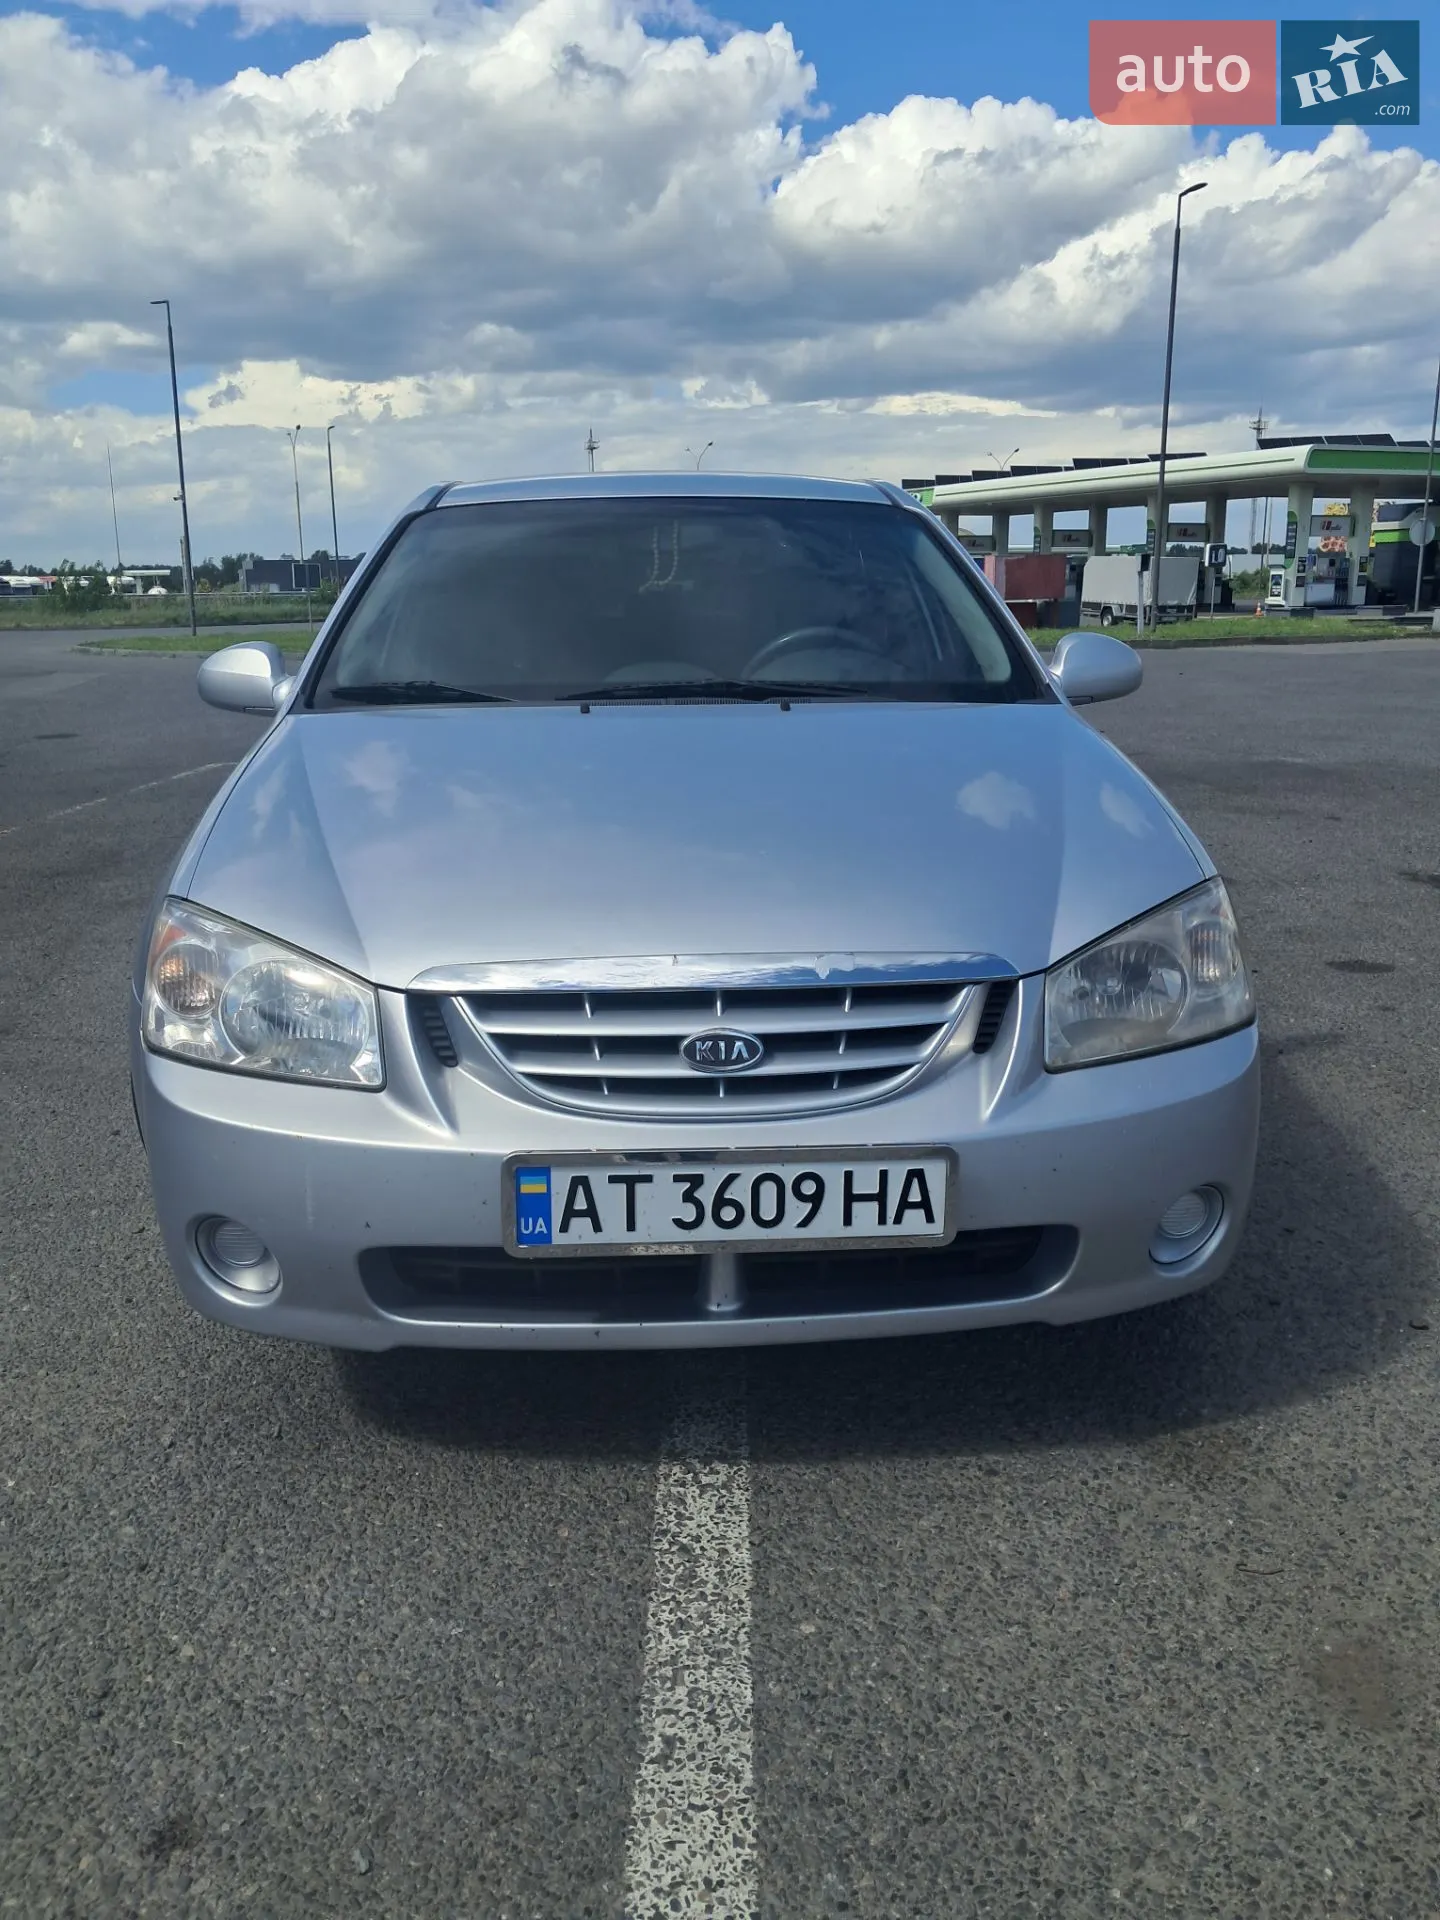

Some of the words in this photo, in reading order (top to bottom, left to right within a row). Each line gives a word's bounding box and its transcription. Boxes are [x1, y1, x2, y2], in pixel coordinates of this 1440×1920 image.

[695, 1040, 750, 1061] KIA
[558, 1174, 654, 1234] AT
[671, 1172, 826, 1231] 3609
[842, 1167, 936, 1227] HA
[520, 1217, 548, 1234] UA
